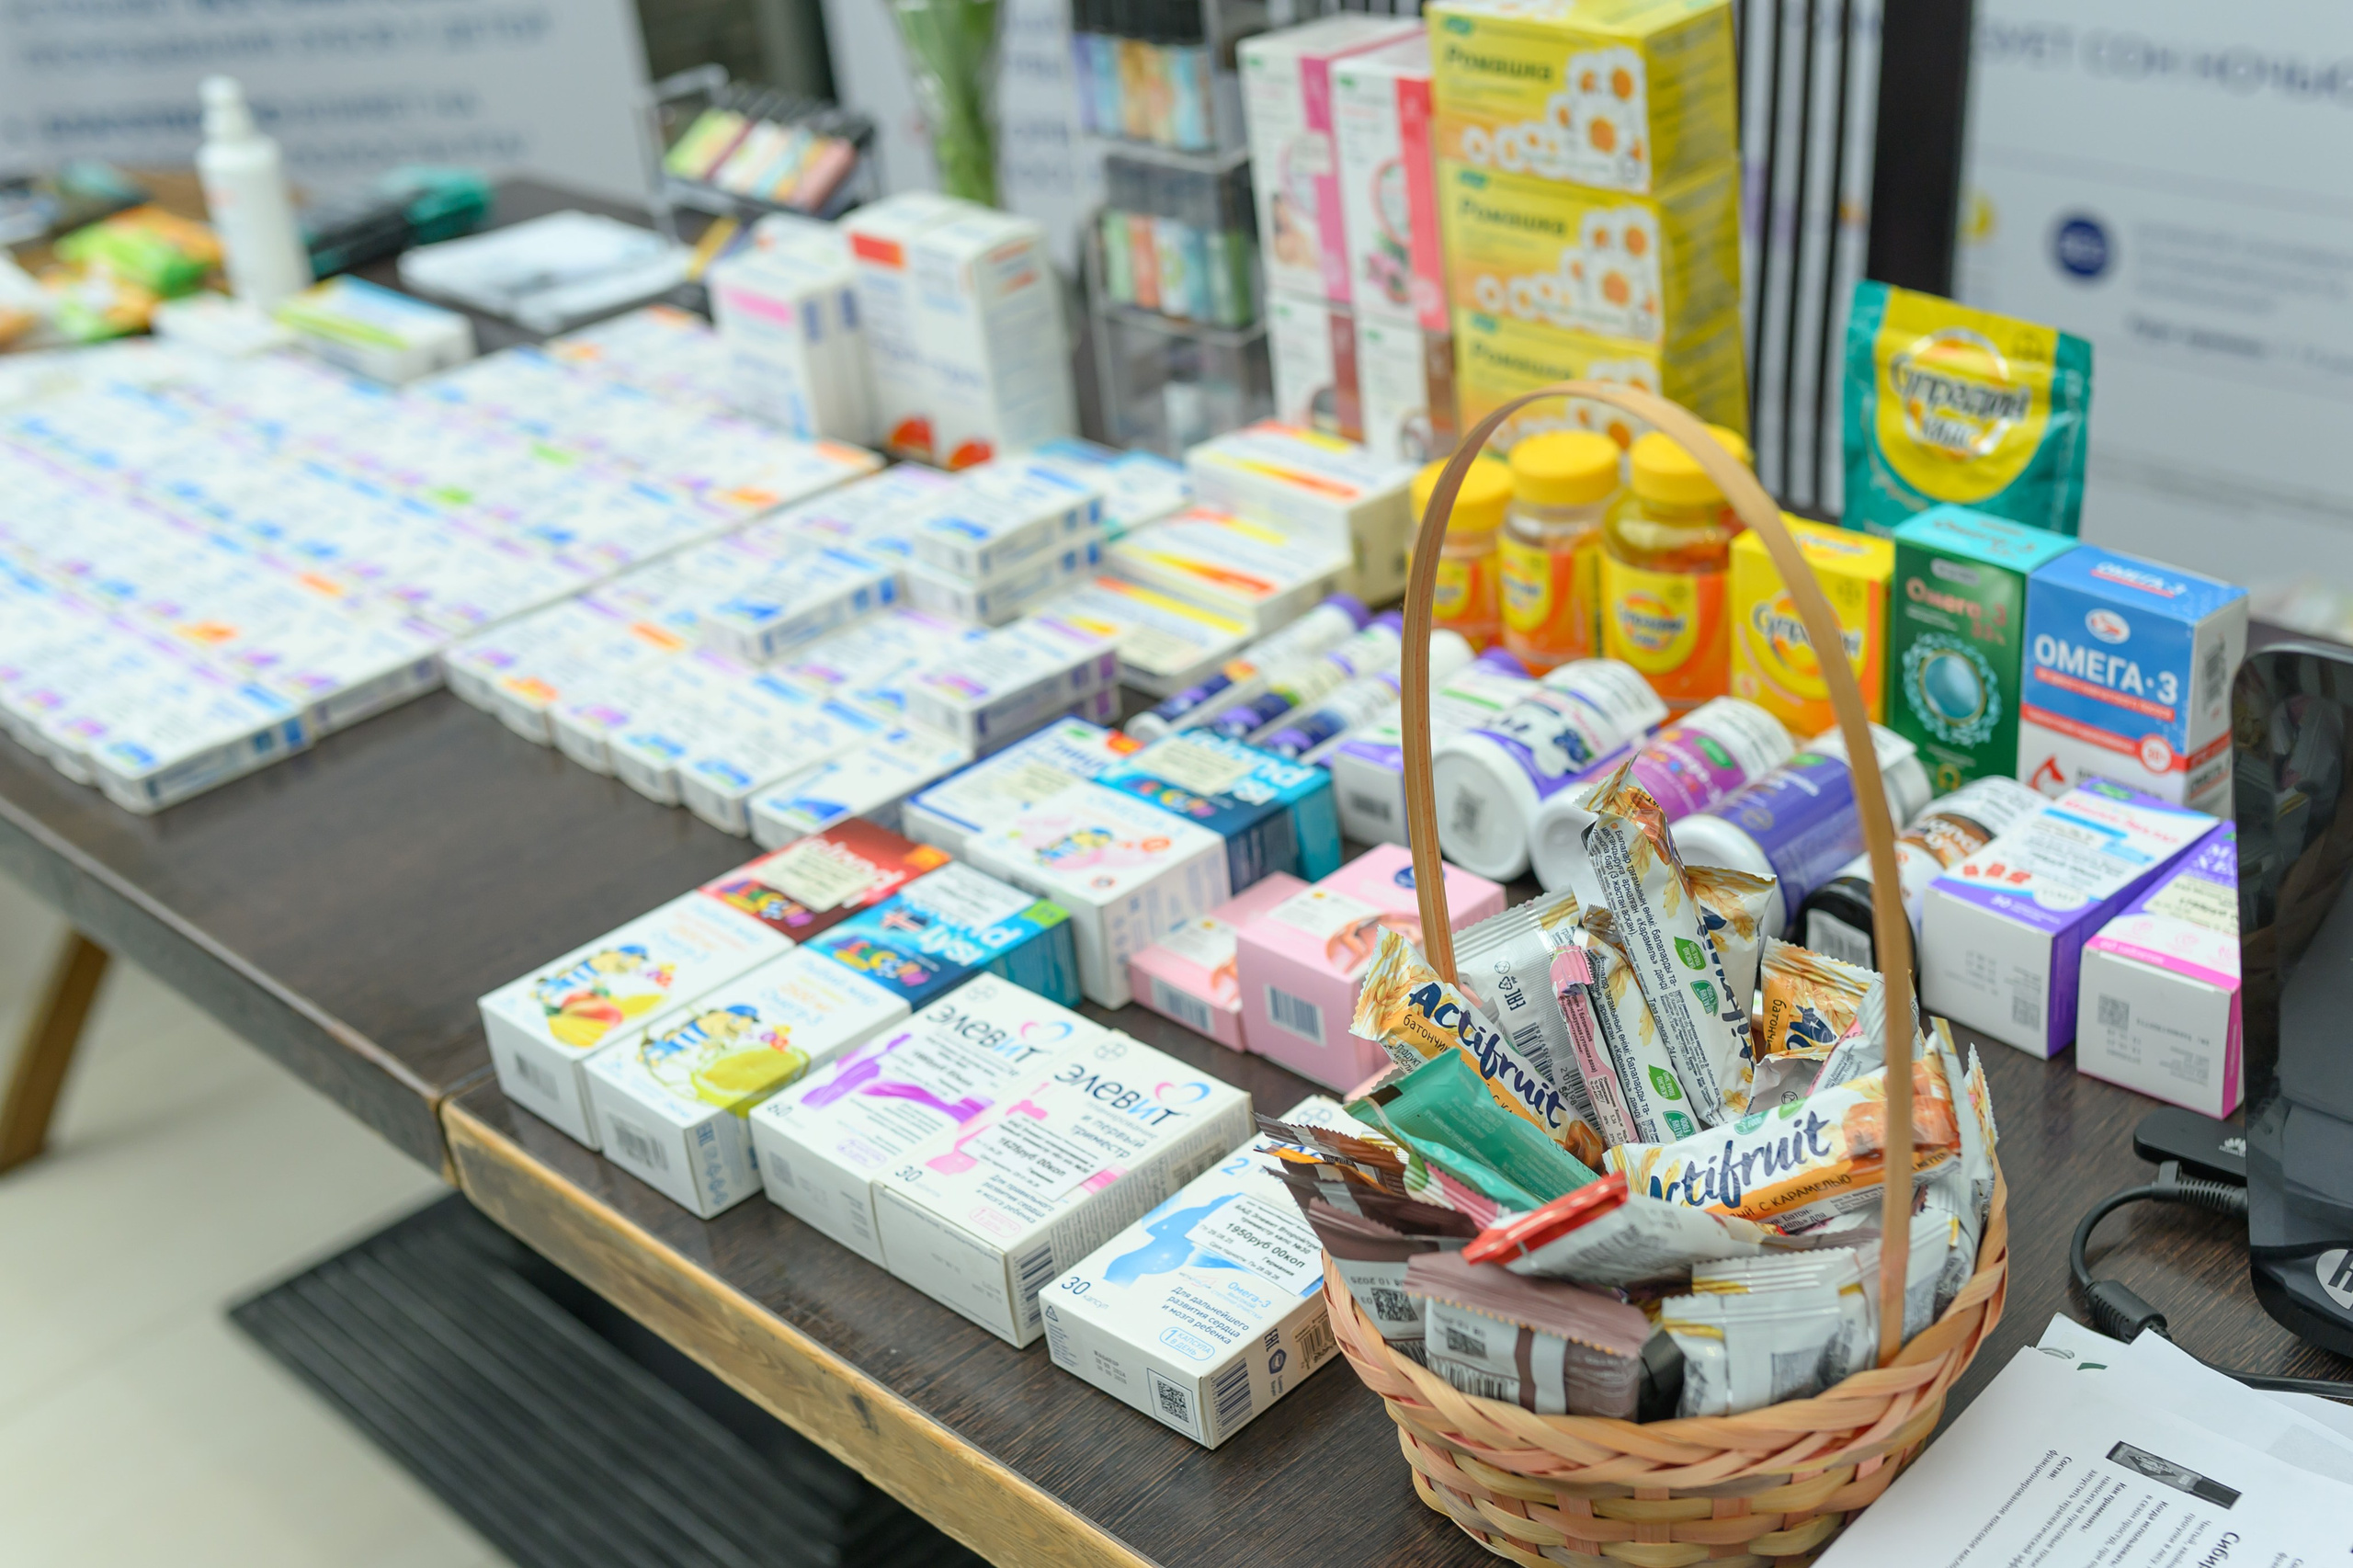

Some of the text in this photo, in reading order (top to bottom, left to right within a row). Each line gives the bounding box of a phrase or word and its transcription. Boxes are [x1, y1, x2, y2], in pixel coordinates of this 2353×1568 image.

[1615, 830, 1631, 864] Балалар
[1408, 983, 1566, 1129] Actifruit
[1770, 1174, 1851, 1207] КАРАМЕЛЬЮ
[1271, 1246, 1306, 1268] 00коп
[1062, 1277, 1090, 1294] 30
[1166, 1295, 1241, 1339] развития сердца
[1170, 1286, 1250, 1332] Для дальнейшего
[1169, 1308, 1195, 1326] мозга
[1194, 1321, 1232, 1346] ребенка
[1177, 1332, 1211, 1355] КАПСУЛА
[1999, 1449, 2059, 1516] фракционированное
[2047, 1455, 2074, 1481] Состав:
[2084, 1475, 2112, 1508] наносите
[2113, 1482, 2128, 1494] Как
[2150, 1500, 2169, 1521] Когда
